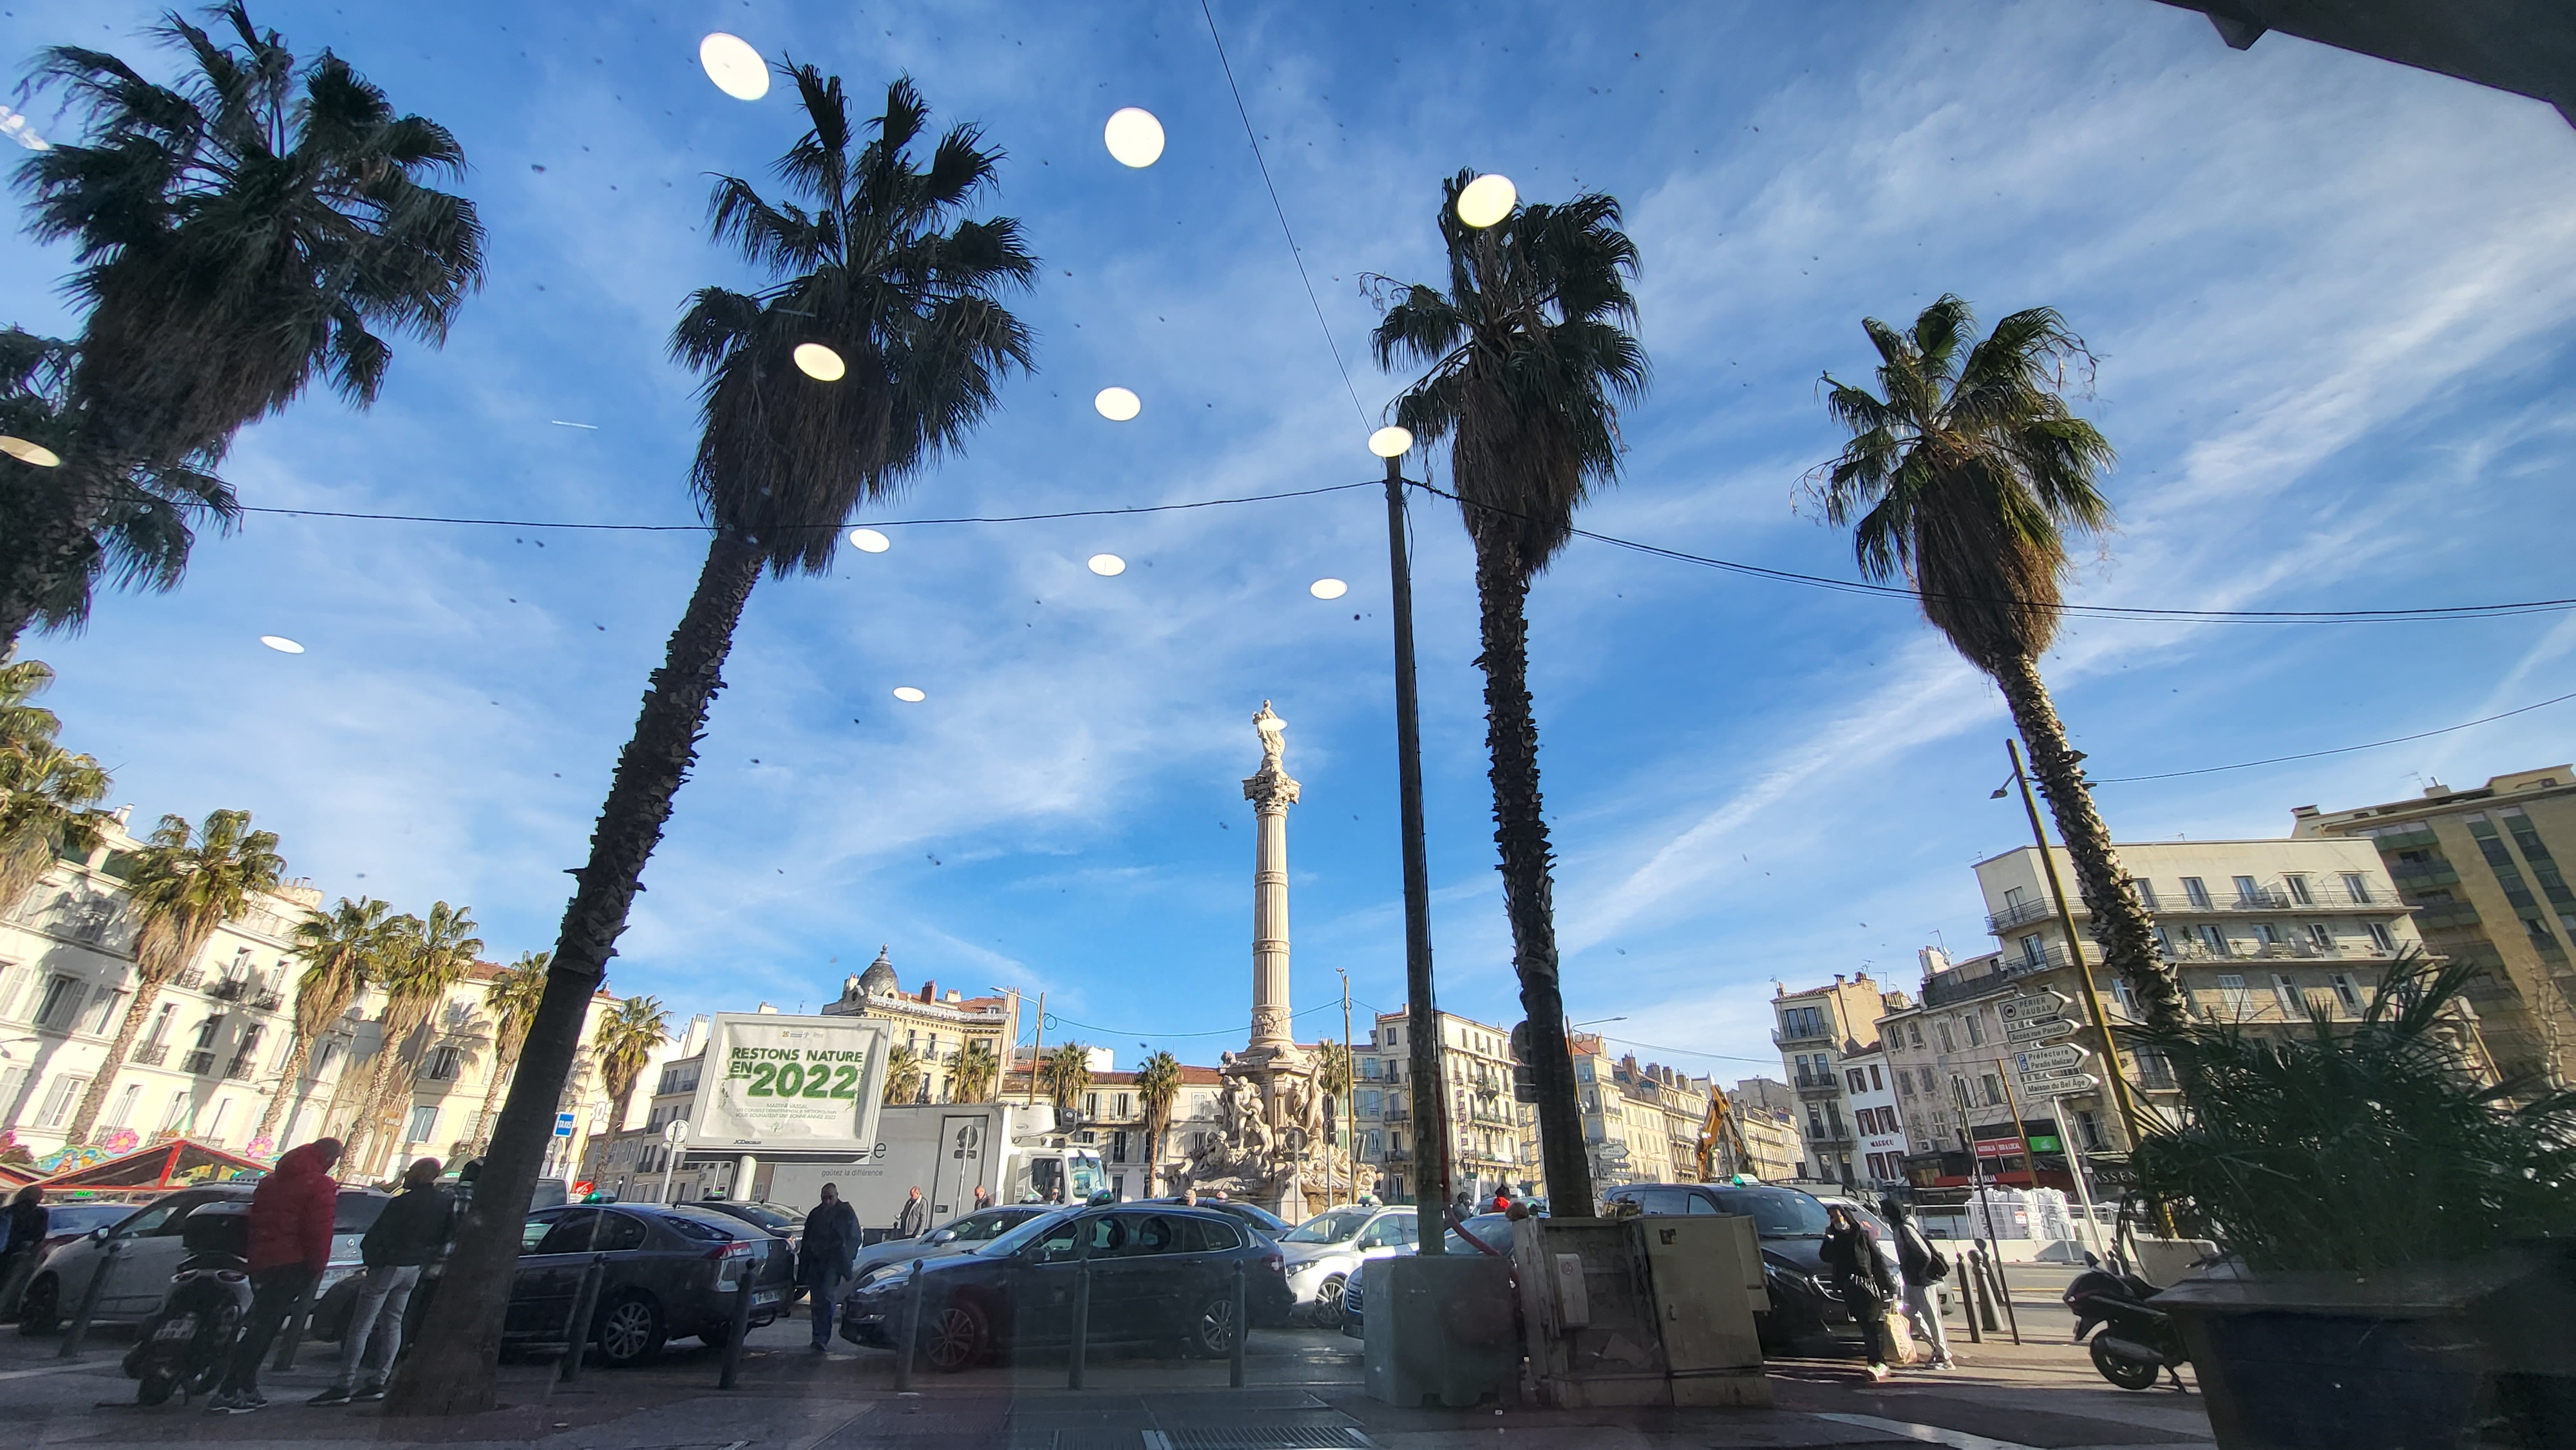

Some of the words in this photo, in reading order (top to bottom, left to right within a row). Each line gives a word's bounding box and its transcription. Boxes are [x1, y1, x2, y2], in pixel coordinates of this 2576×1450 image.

[2019, 997, 2046, 1008] PÉRIER
[2020, 1004, 2052, 1017] VAUBAN
[2012, 1032, 2030, 1041] Accès
[2031, 1029, 2041, 1037] rue
[2042, 1024, 2065, 1034] Paradis
[731, 1047, 800, 1060] RESTONS
[806, 1050, 864, 1062] NATURE
[2029, 1049, 2069, 1060] Préfecture
[730, 1061, 753, 1073] EN
[747, 1062, 858, 1098] 2022
[2028, 1084, 2050, 1093] Maison
[1456, 1078, 1470, 1171] PHARMACI
[822, 1169, 843, 1177] goûtez
